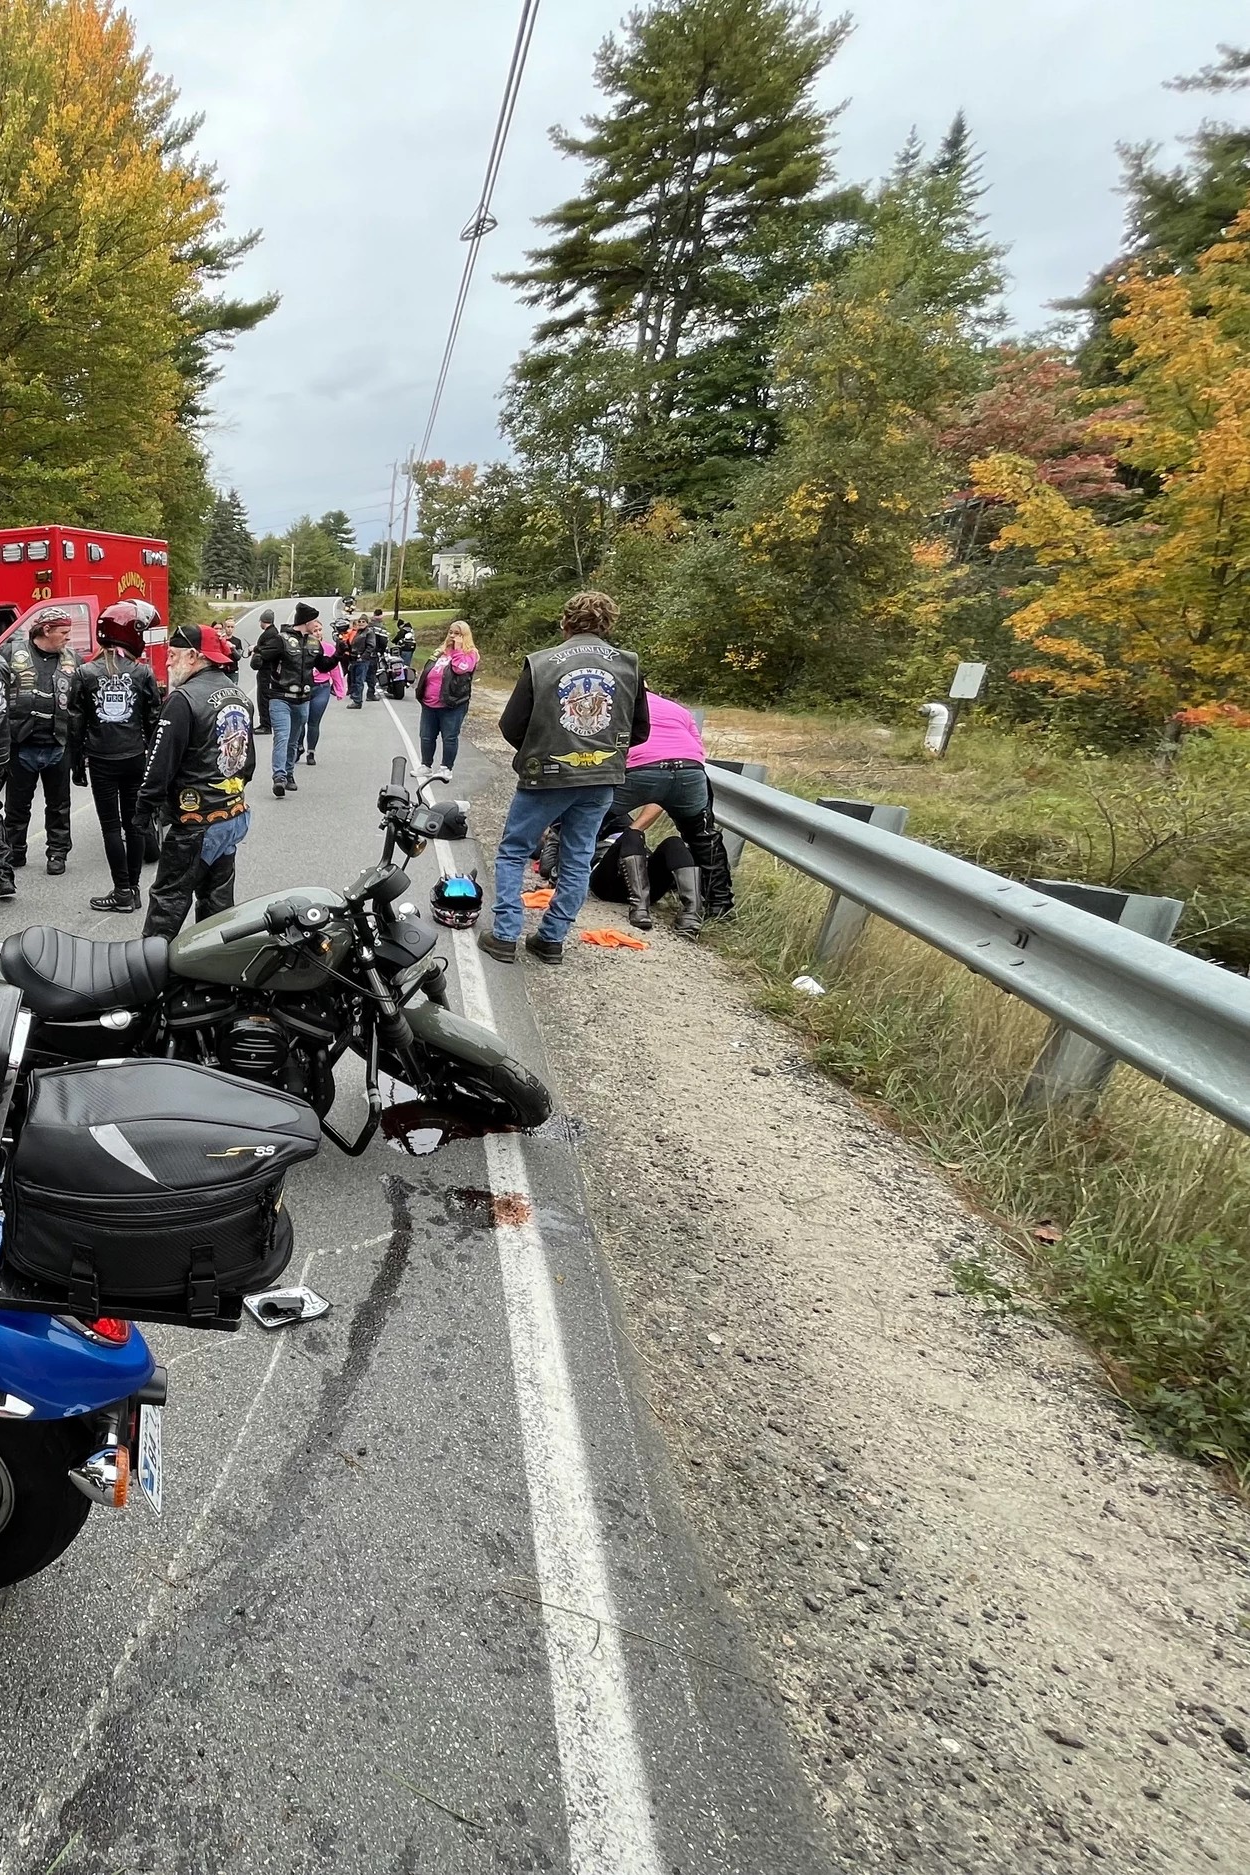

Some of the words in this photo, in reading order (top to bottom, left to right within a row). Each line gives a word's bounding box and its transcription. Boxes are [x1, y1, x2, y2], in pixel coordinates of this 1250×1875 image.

[117, 571, 146, 598] ARUNDEL
[31, 587, 51, 600] 40
[579, 669, 606, 677] TWIN
